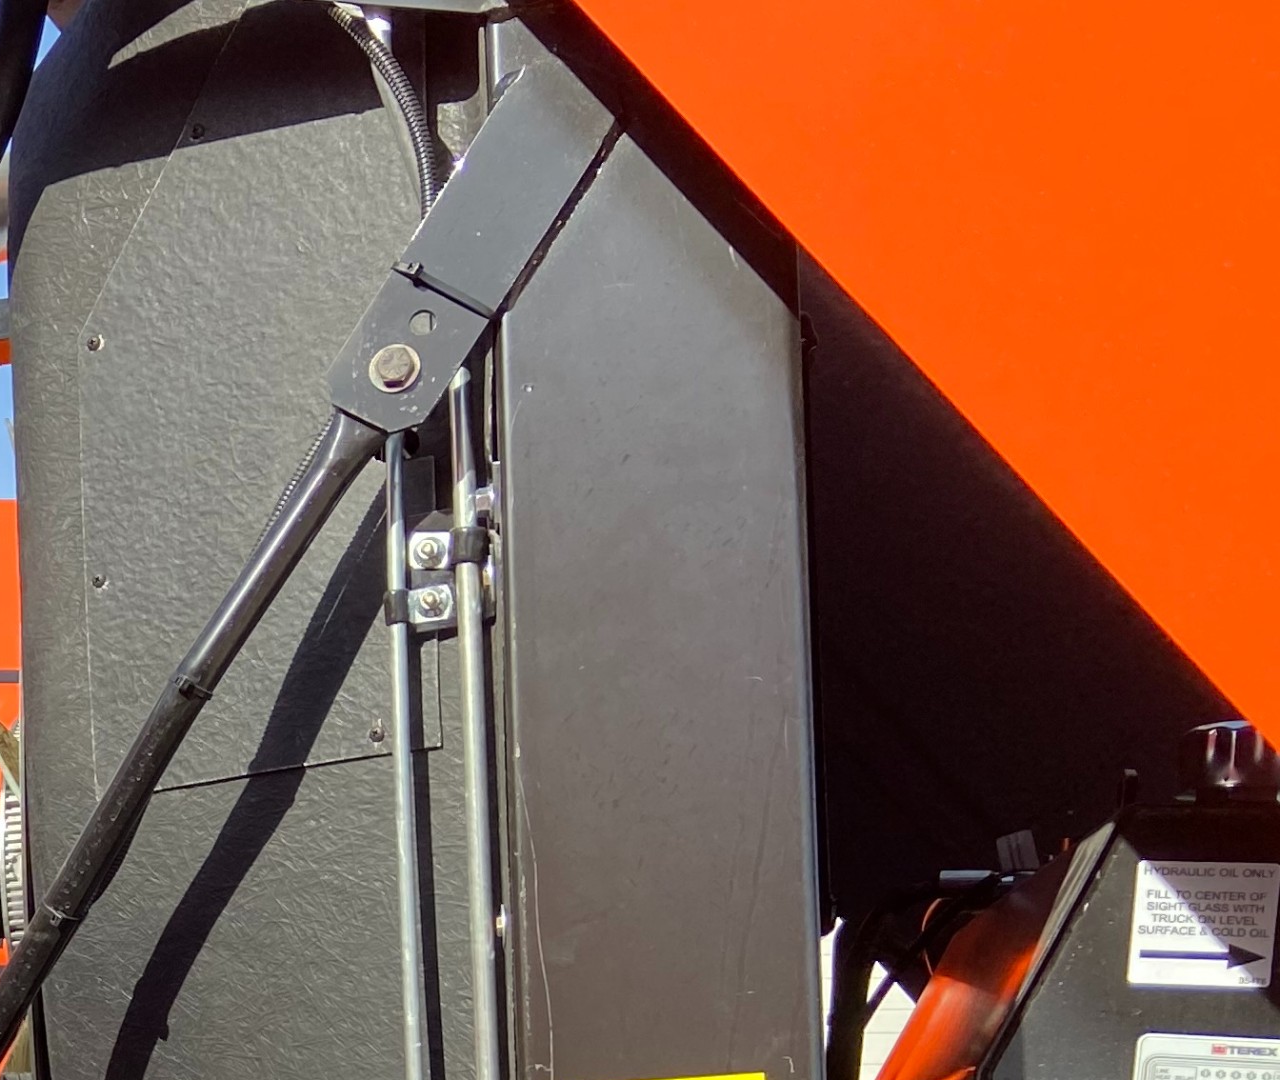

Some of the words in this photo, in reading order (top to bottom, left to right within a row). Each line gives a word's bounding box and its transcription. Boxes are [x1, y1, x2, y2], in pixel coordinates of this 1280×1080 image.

[1144, 866, 1215, 877] HYDRAULIC
[1220, 868, 1238, 877] OIL
[1243, 868, 1275, 878] ONLY
[1147, 890, 1169, 899] FILL
[1176, 890, 1191, 899] TO
[1195, 891, 1246, 900] CENTER
[1250, 892, 1267, 901] OF
[1147, 902, 1185, 911] SIGHT
[1188, 903, 1228, 912] GLASS
[1233, 904, 1265, 913] WITH
[1152, 914, 1193, 923] TRUCK
[1198, 915, 1215, 924] ON
[1220, 916, 1257, 926] LEVEL
[1138, 925, 1195, 936] SURFACE
[1200, 927, 1208, 936] &
[1212, 927, 1246, 937] COLD
[1249, 929, 1269, 938] OIL
[1228, 1047, 1278, 1056] TEREX
